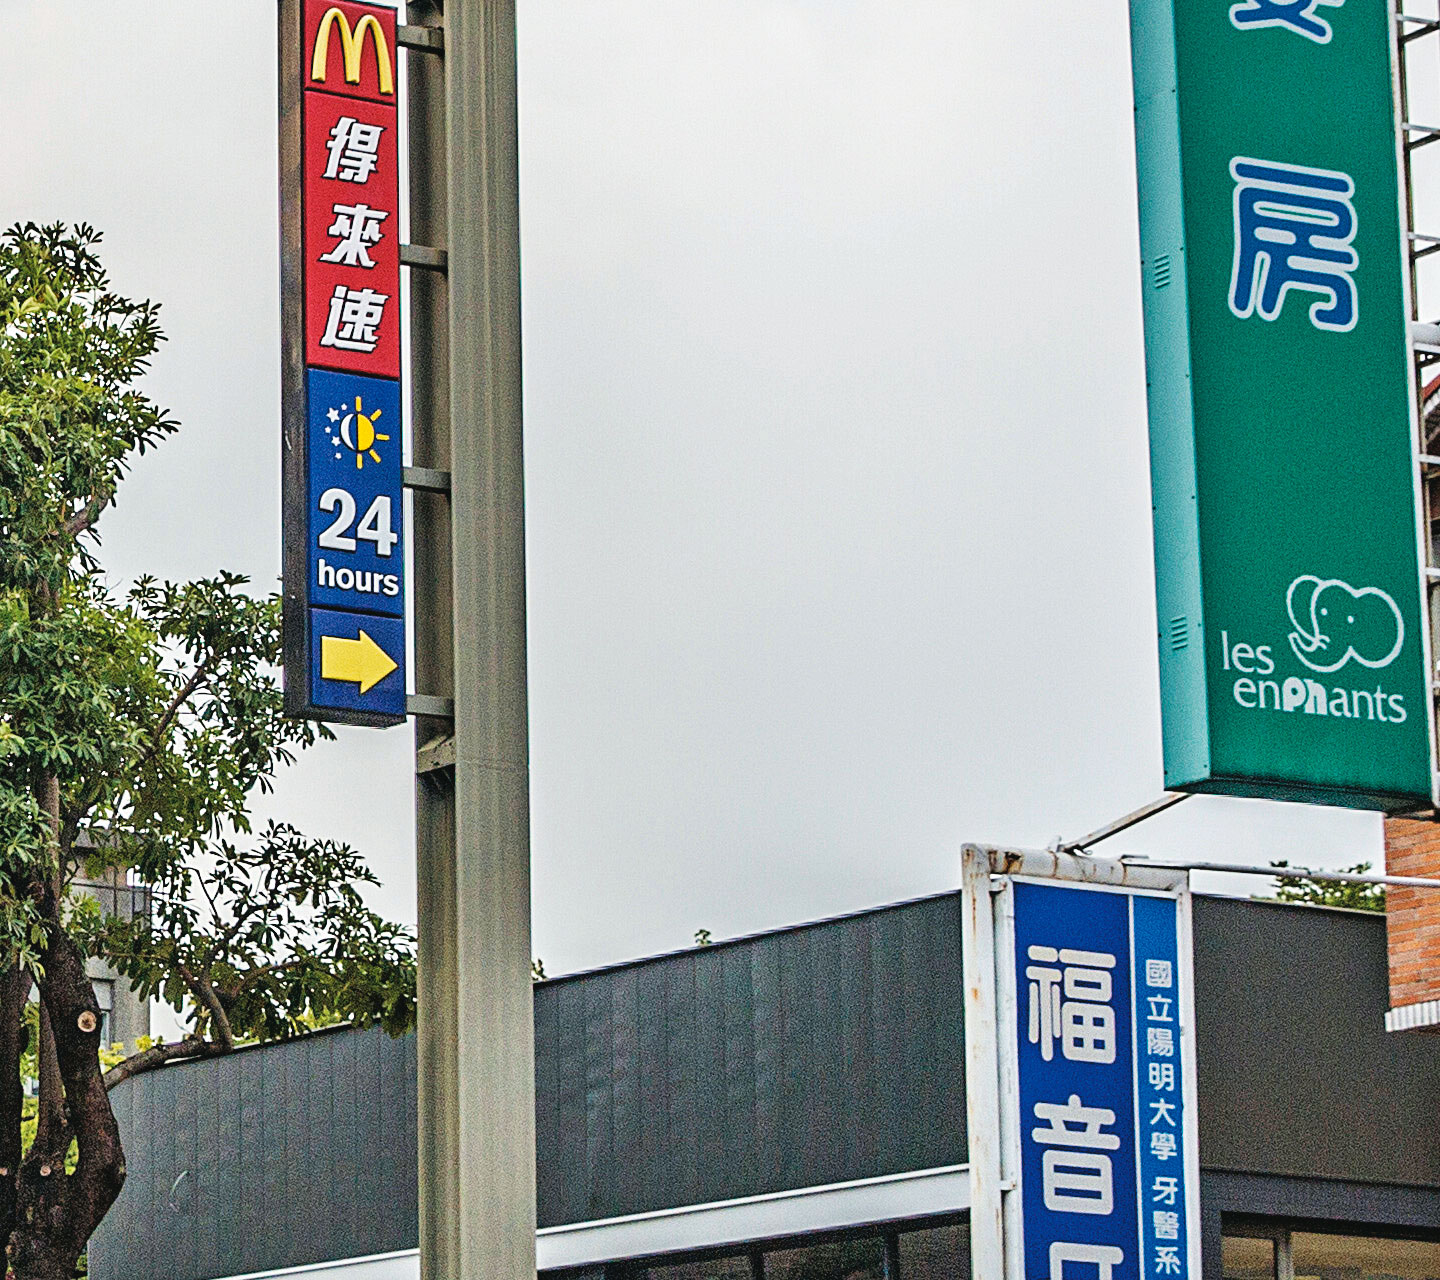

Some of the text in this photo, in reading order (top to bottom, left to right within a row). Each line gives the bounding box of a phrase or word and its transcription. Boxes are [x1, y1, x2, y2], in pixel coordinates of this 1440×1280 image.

[320, 116, 388, 353] 得來速
[318, 486, 398, 557] 24
[318, 558, 400, 599] hours
[1221, 629, 1275, 675] les
